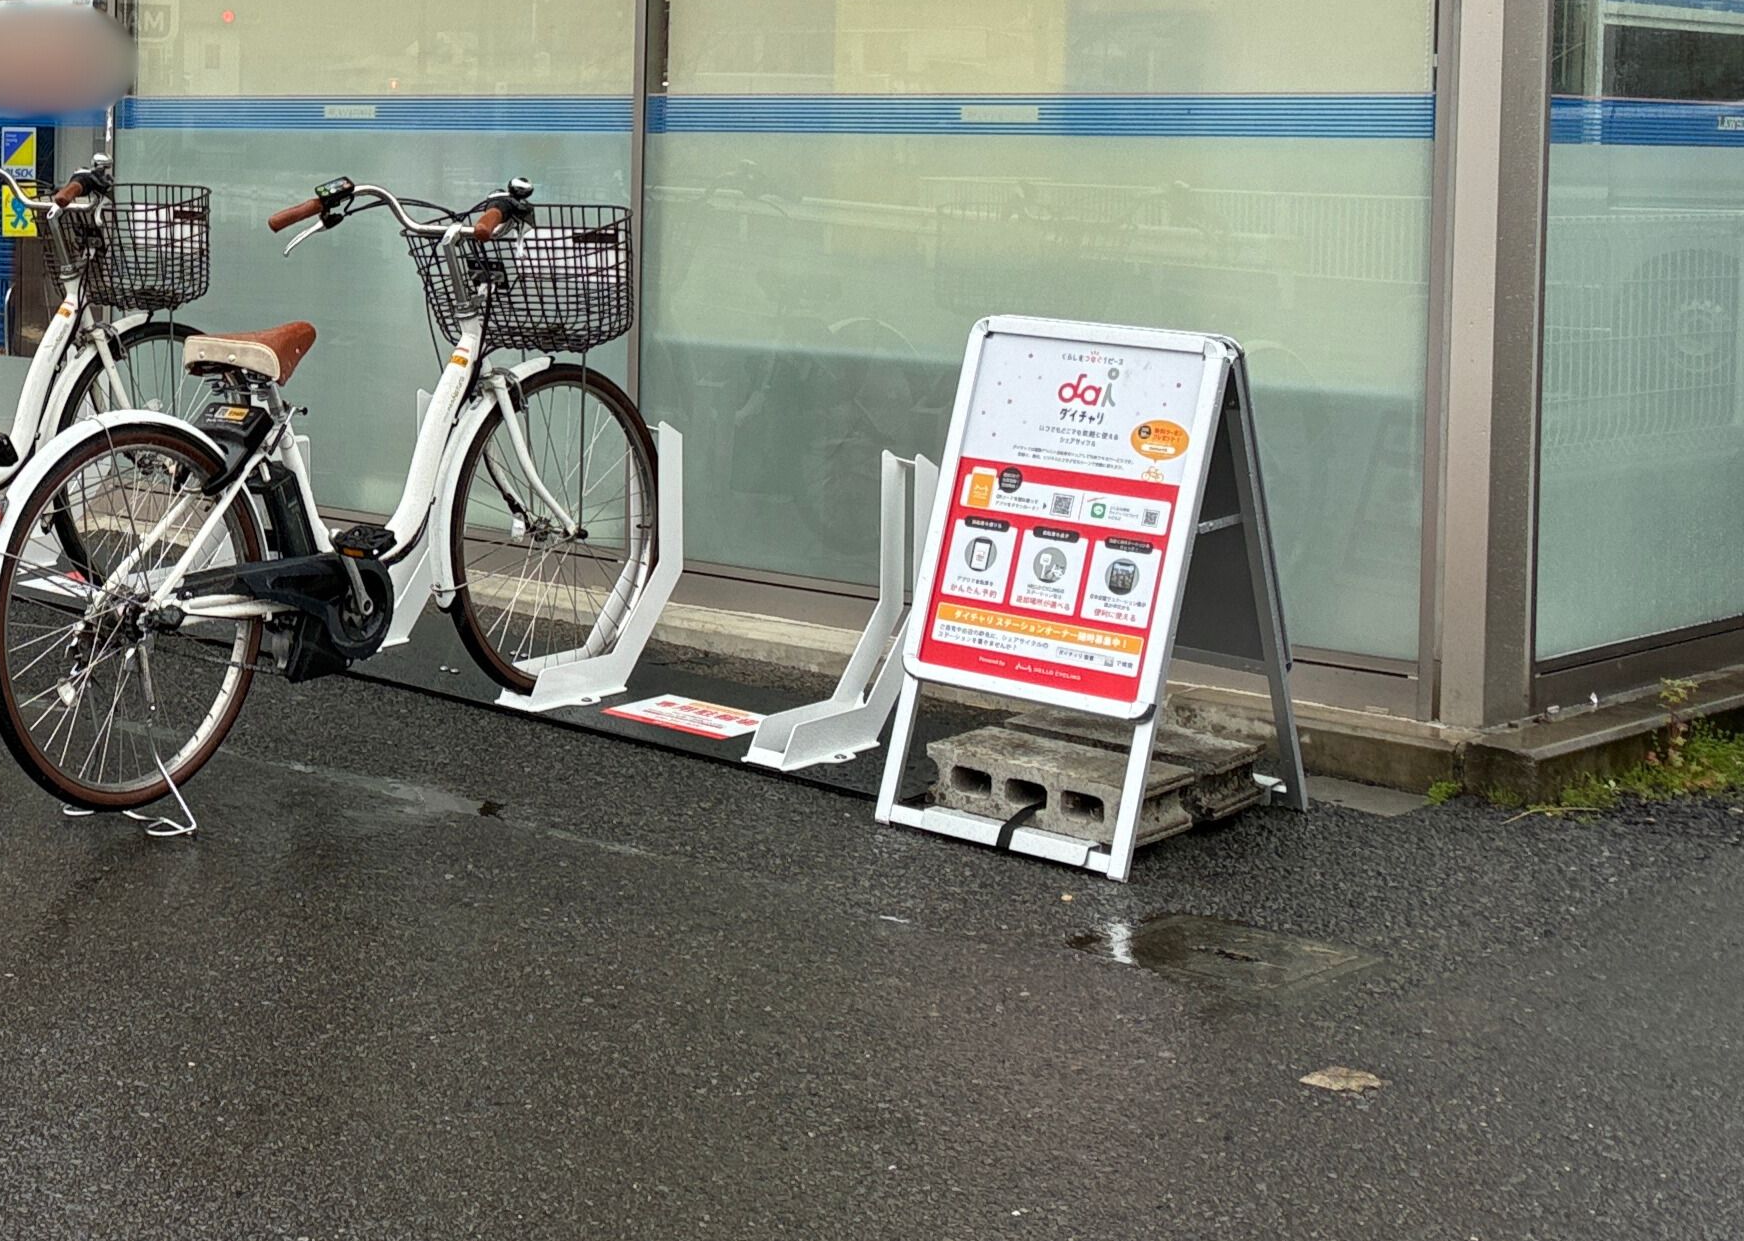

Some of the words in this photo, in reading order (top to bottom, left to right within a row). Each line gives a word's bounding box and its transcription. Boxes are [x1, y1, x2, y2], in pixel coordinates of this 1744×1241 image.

[1717, 115, 1744, 130] LAWS
[1057, 406, 1105, 425] ダイチャリ
[953, 609, 994, 625] ダイチャリ
